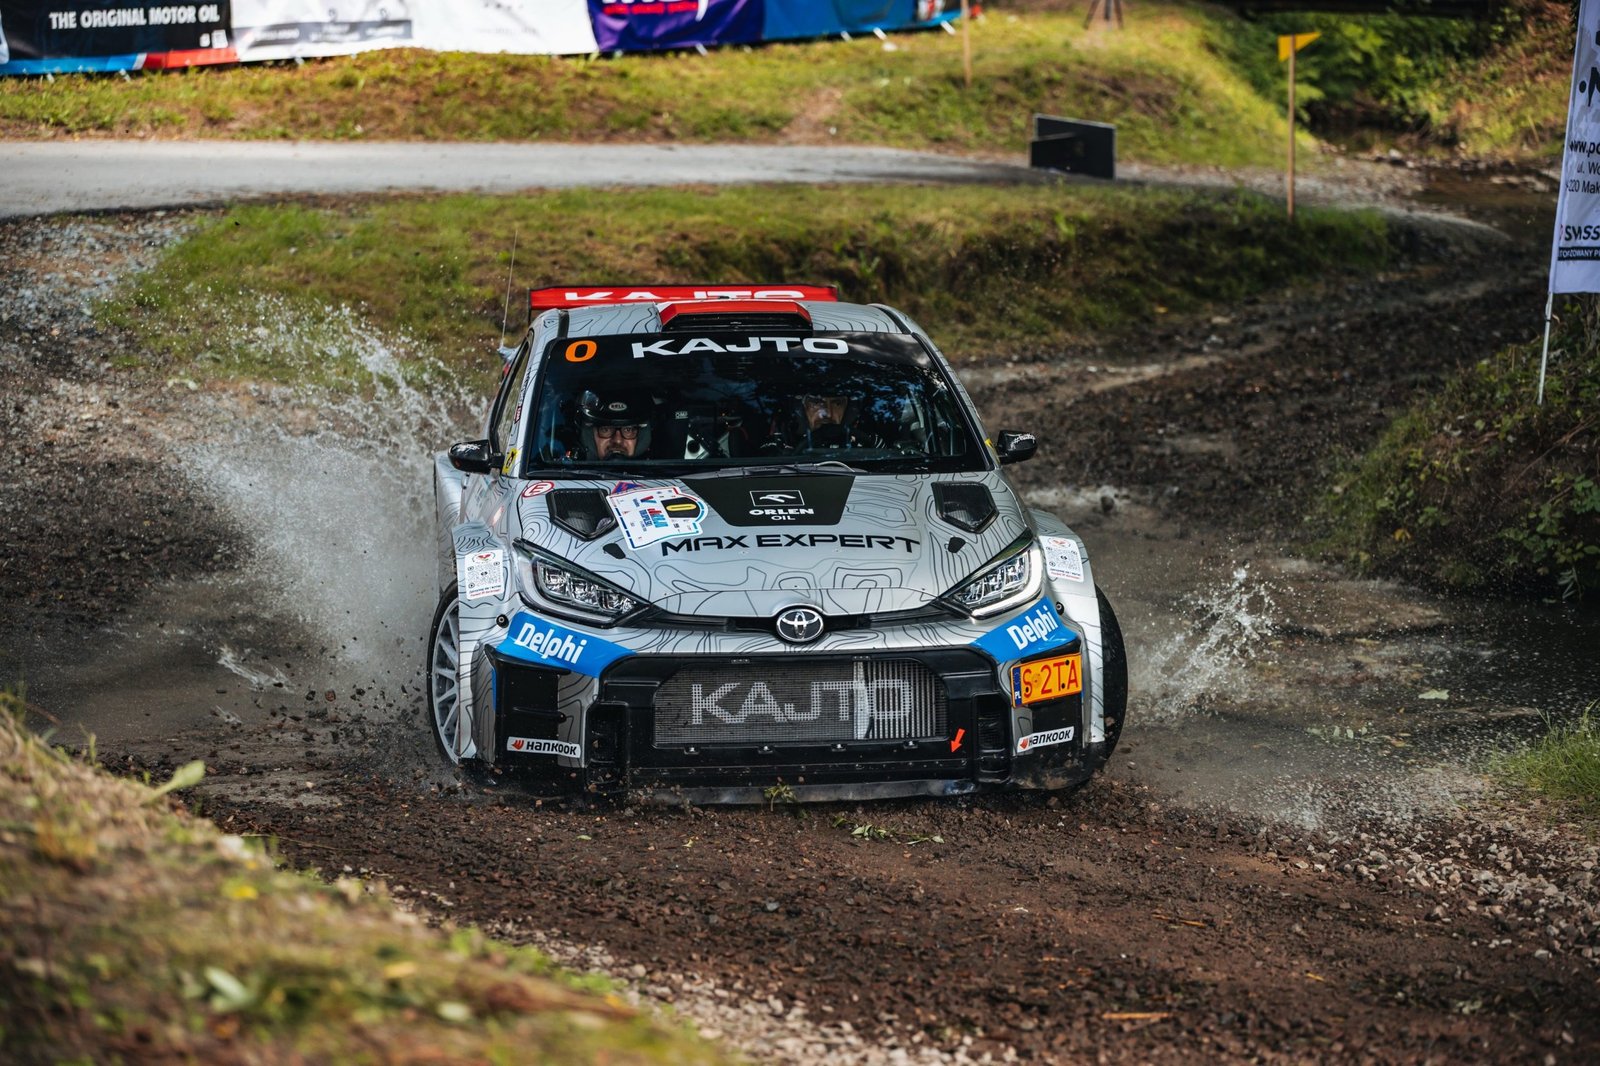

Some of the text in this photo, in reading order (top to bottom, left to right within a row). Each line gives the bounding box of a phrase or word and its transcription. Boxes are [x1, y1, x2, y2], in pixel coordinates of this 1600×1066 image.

[49, 4, 220, 30] THE ORIGINAL MOTOR OIL
[632, 337, 849, 359] KAJTO
[662, 534, 920, 556] MAX EXPERT
[514, 622, 588, 665] Delphi
[1007, 605, 1059, 650] Delphi
[691, 679, 912, 725] KAJTO
